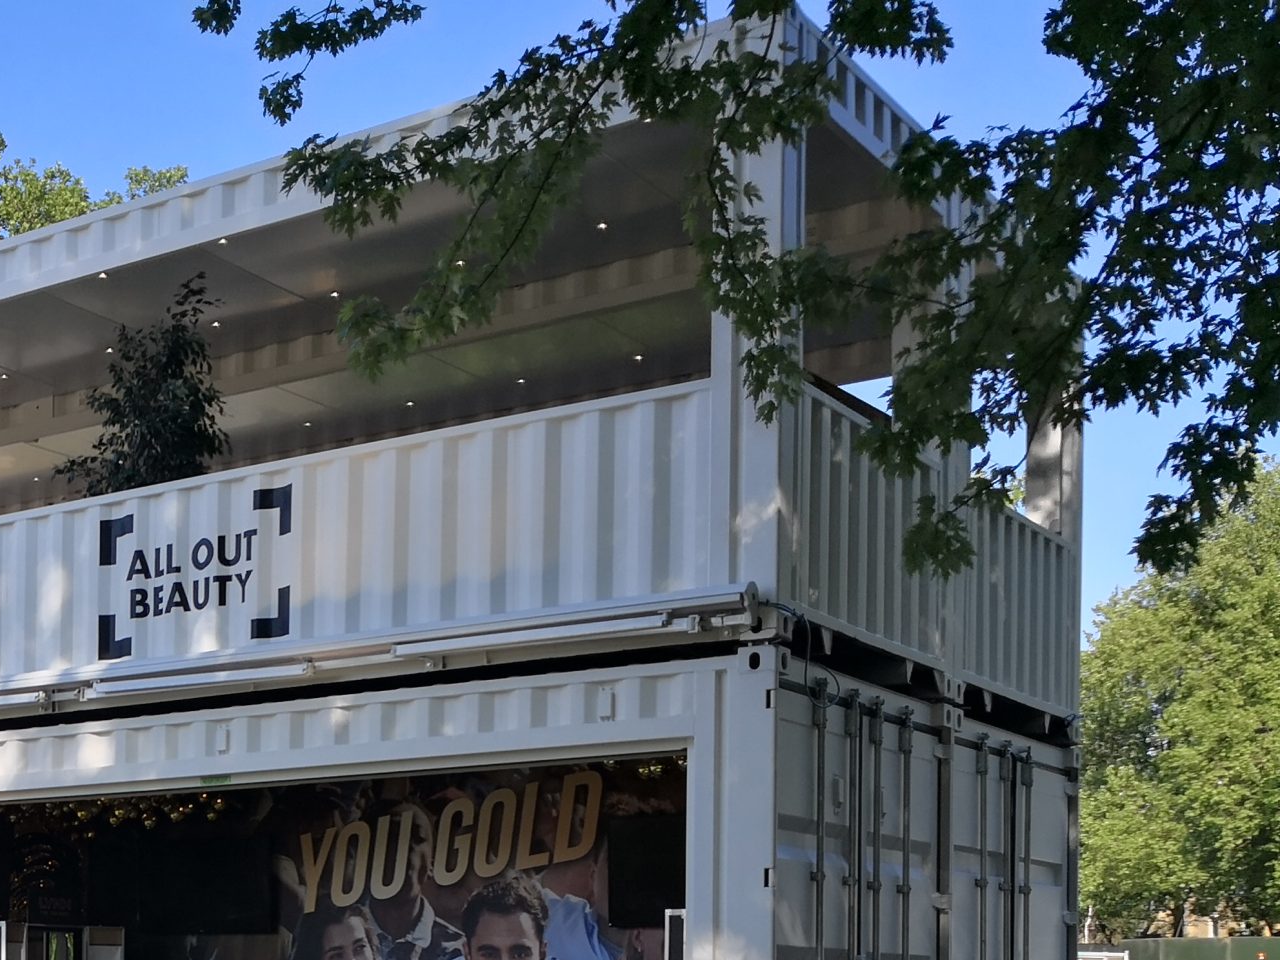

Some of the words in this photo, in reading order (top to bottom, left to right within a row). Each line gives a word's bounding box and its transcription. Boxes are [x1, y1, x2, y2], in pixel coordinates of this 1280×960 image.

[126, 543, 181, 581] ALL
[191, 528, 258, 571] OUT
[130, 569, 253, 619] BEAUTY
[300, 811, 413, 914] YOU
[432, 771, 603, 886] GOLD
